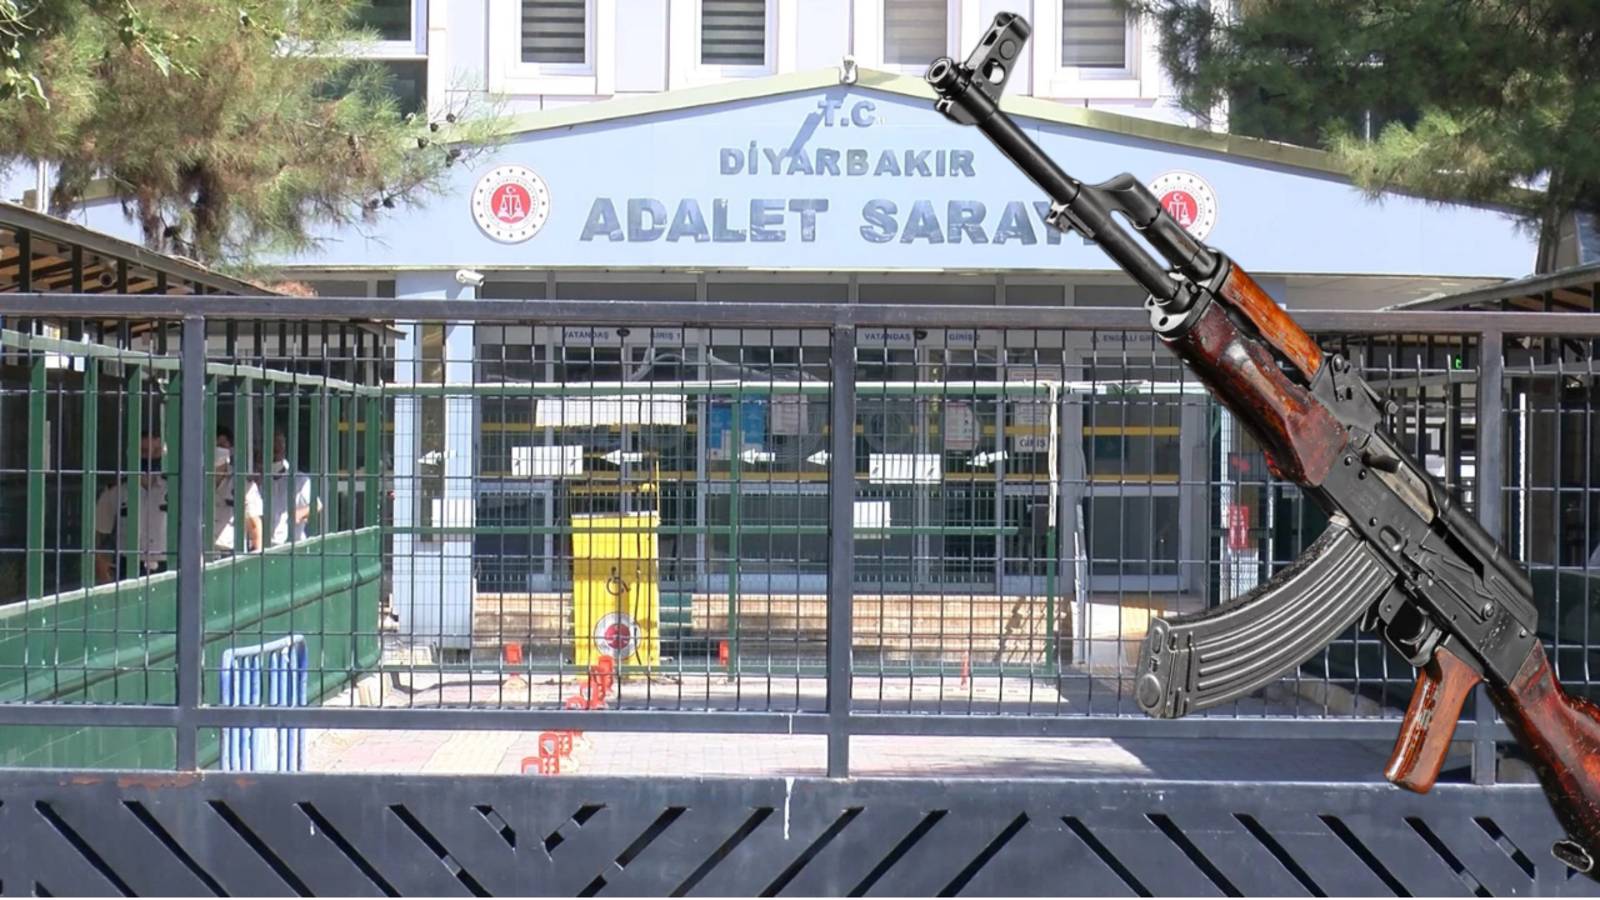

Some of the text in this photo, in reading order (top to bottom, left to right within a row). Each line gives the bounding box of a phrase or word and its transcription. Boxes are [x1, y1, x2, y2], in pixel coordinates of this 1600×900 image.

[719, 140, 976, 177] DİYARBAKIR
[579, 197, 829, 243] ADALET
[859, 198, 1097, 246] SARAY
